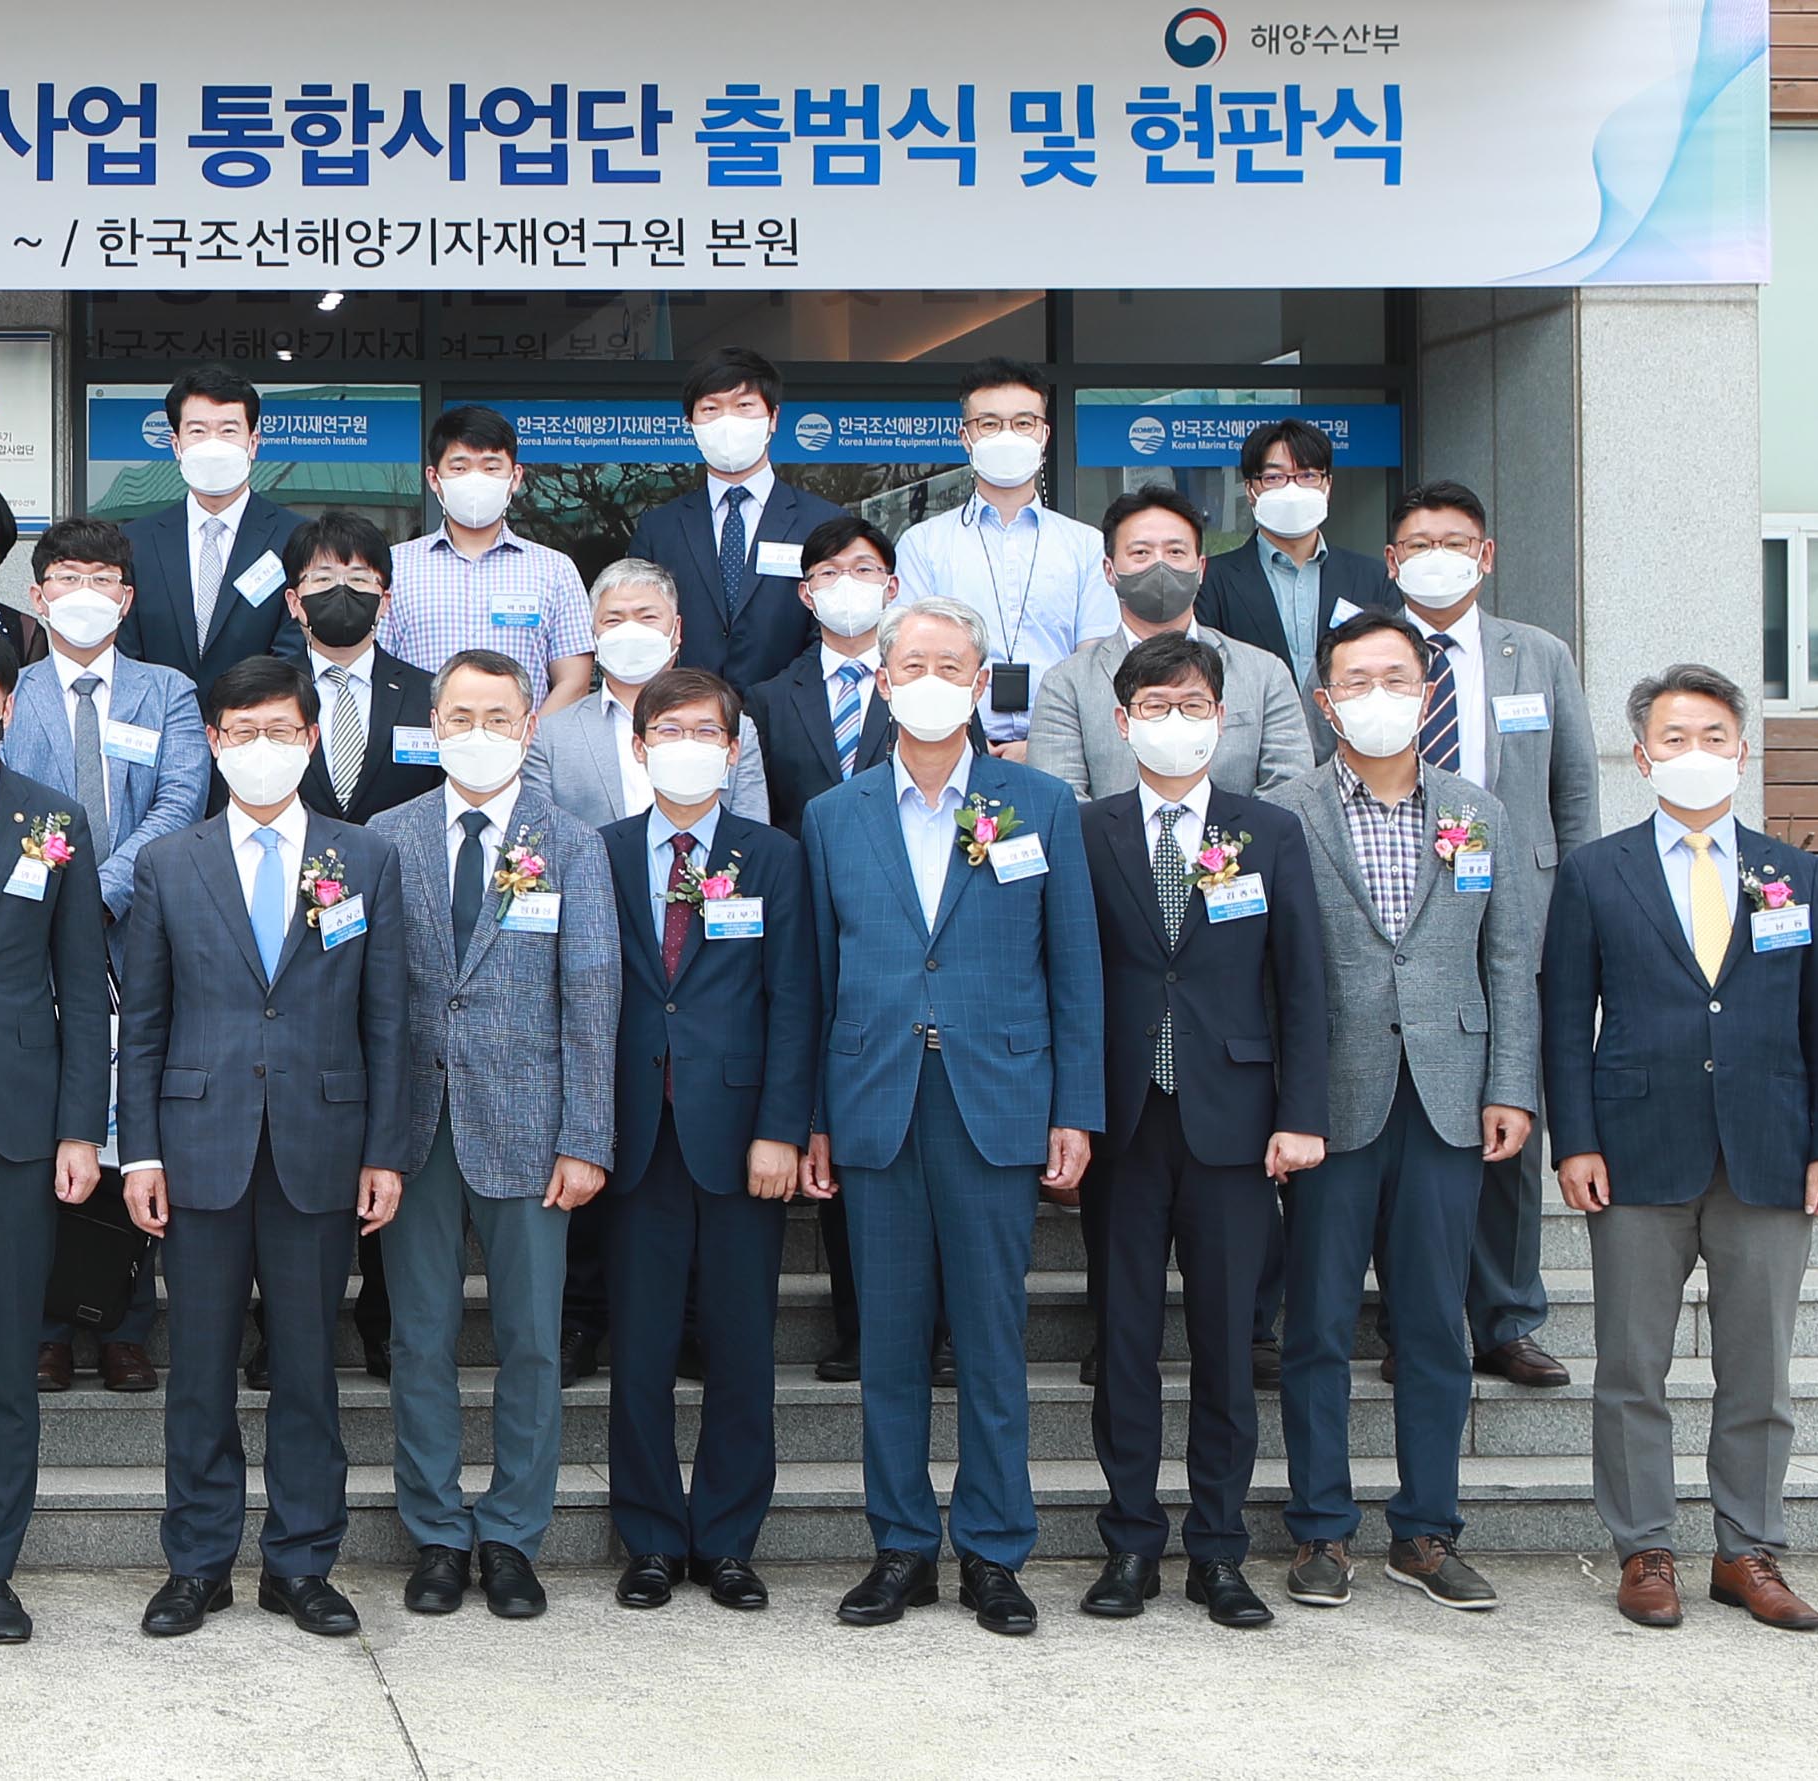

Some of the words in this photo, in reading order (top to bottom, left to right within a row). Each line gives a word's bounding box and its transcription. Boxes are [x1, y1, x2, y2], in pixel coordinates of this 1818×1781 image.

[1250, 22, 1401, 57] 해양수산부
[187, 83, 674, 189] 통합사업단
[694, 84, 977, 187] 출범식
[1009, 84, 1098, 188] 및
[1125, 84, 1403, 187] 현판식
[60, 218, 79, 268] /
[96, 217, 686, 269] 한국조선해양기자재연구원
[705, 217, 799, 268] 본원
[291, 436, 331, 446] Research
[333, 436, 368, 446] Institute
[516, 437, 542, 446] Korea
[543, 437, 572, 446] Marine
[573, 437, 619, 448] Equipment
[621, 437, 660, 446] Research
[838, 437, 863, 447] Korea
[865, 437, 893, 447] Marine
[895, 437, 940, 449] Equipment
[1171, 440, 1196, 450] Korea
[1198, 440, 1226, 450] Marine
